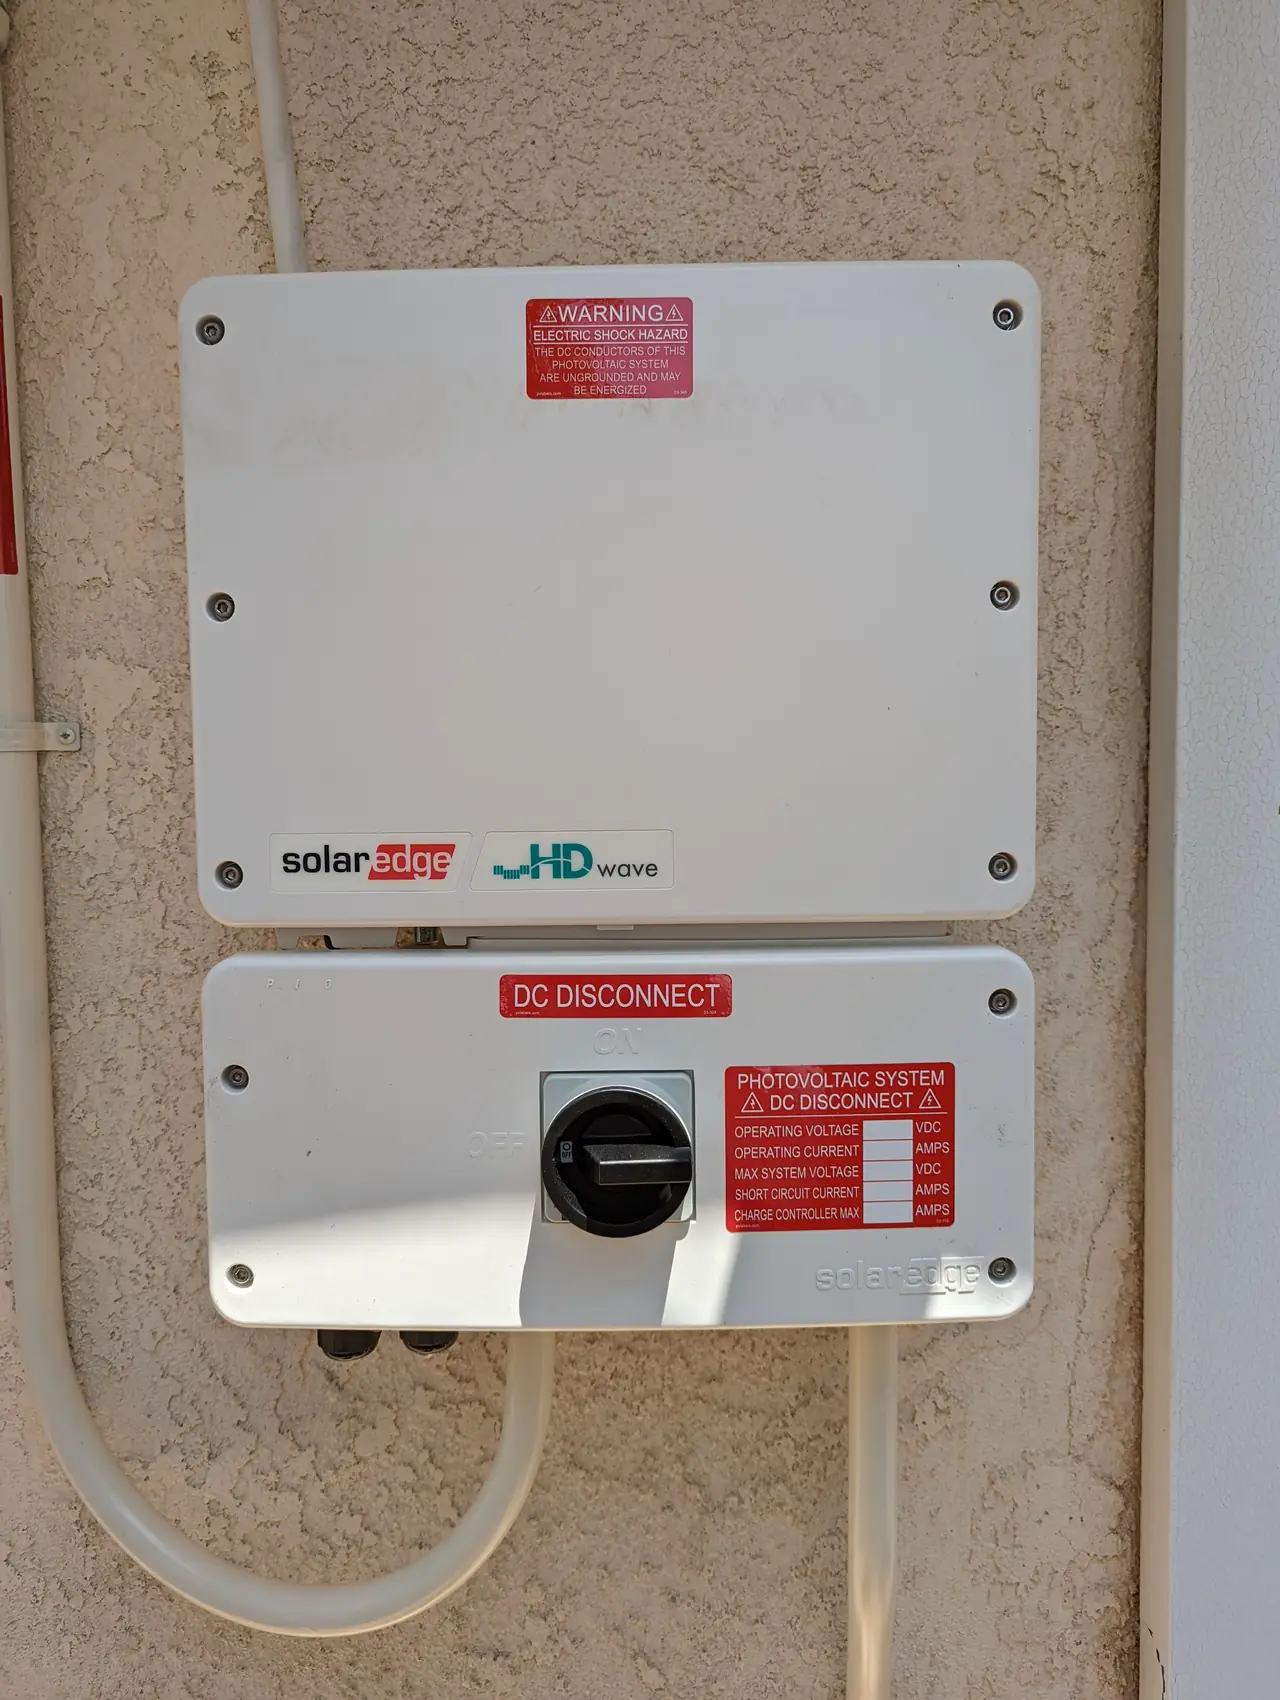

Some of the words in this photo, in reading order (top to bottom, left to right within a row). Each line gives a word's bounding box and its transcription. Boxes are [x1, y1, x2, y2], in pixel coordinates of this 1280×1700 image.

[558, 304, 664, 322] WARNING
[533, 330, 590, 341] ELECTRIC
[594, 329, 635, 340] SHOCK
[639, 328, 688, 340] HAZARD
[535, 348, 554, 357] THE
[558, 347, 571, 356] DC
[574, 346, 644, 356] CONDUCTORS
[647, 346, 660, 356] OF
[664, 346, 685, 356] THIS
[552, 360, 626, 370] PHOTOVOLTAIC
[629, 360, 669, 369] SYSTEM
[540, 373, 559, 382] ARE
[563, 372, 634, 382] UNGROUNDED
[637, 372, 658, 381] AND
[661, 372, 681, 381] MAY
[574, 386, 587, 395] BE
[590, 385, 646, 395] ENERGIZED
[282, 844, 452, 880] solaredge
[530, 844, 594, 879] HD
[598, 863, 658, 877] wave
[514, 984, 548, 1008] DC
[557, 984, 720, 1008] DISCONNECT
[738, 1072, 870, 1089] PHOTOVOLTAIC
[874, 1070, 945, 1087] SYSTEM
[770, 1094, 795, 1111] DC
[800, 1092, 914, 1110] DISCONNECT
[734, 1125, 802, 1138] OPERATING
[806, 1124, 859, 1137] VOLTAGE
[915, 1121, 941, 1133] VDC
[734, 1146, 800, 1159] OPERATING
[803, 1144, 859, 1158] CURRENT
[915, 1142, 950, 1154] AMPS
[735, 1167, 758, 1180] MAX
[761, 1167, 806, 1179] SYSTEM
[809, 1166, 859, 1178] VOLTAGE
[915, 1163, 941, 1174] VDC
[735, 1188, 768, 1201] SHORT
[771, 1187, 810, 1200] CIRCUIT
[812, 1186, 859, 1199] CURRENT
[915, 1183, 950, 1195] AMPS
[734, 1209, 773, 1221] CHARGE
[775, 1208, 837, 1220] CONTROLLER
[840, 1207, 859, 1218] MAX
[915, 1204, 950, 1216] AMPS
[815, 1257, 981, 1292] solaredge
